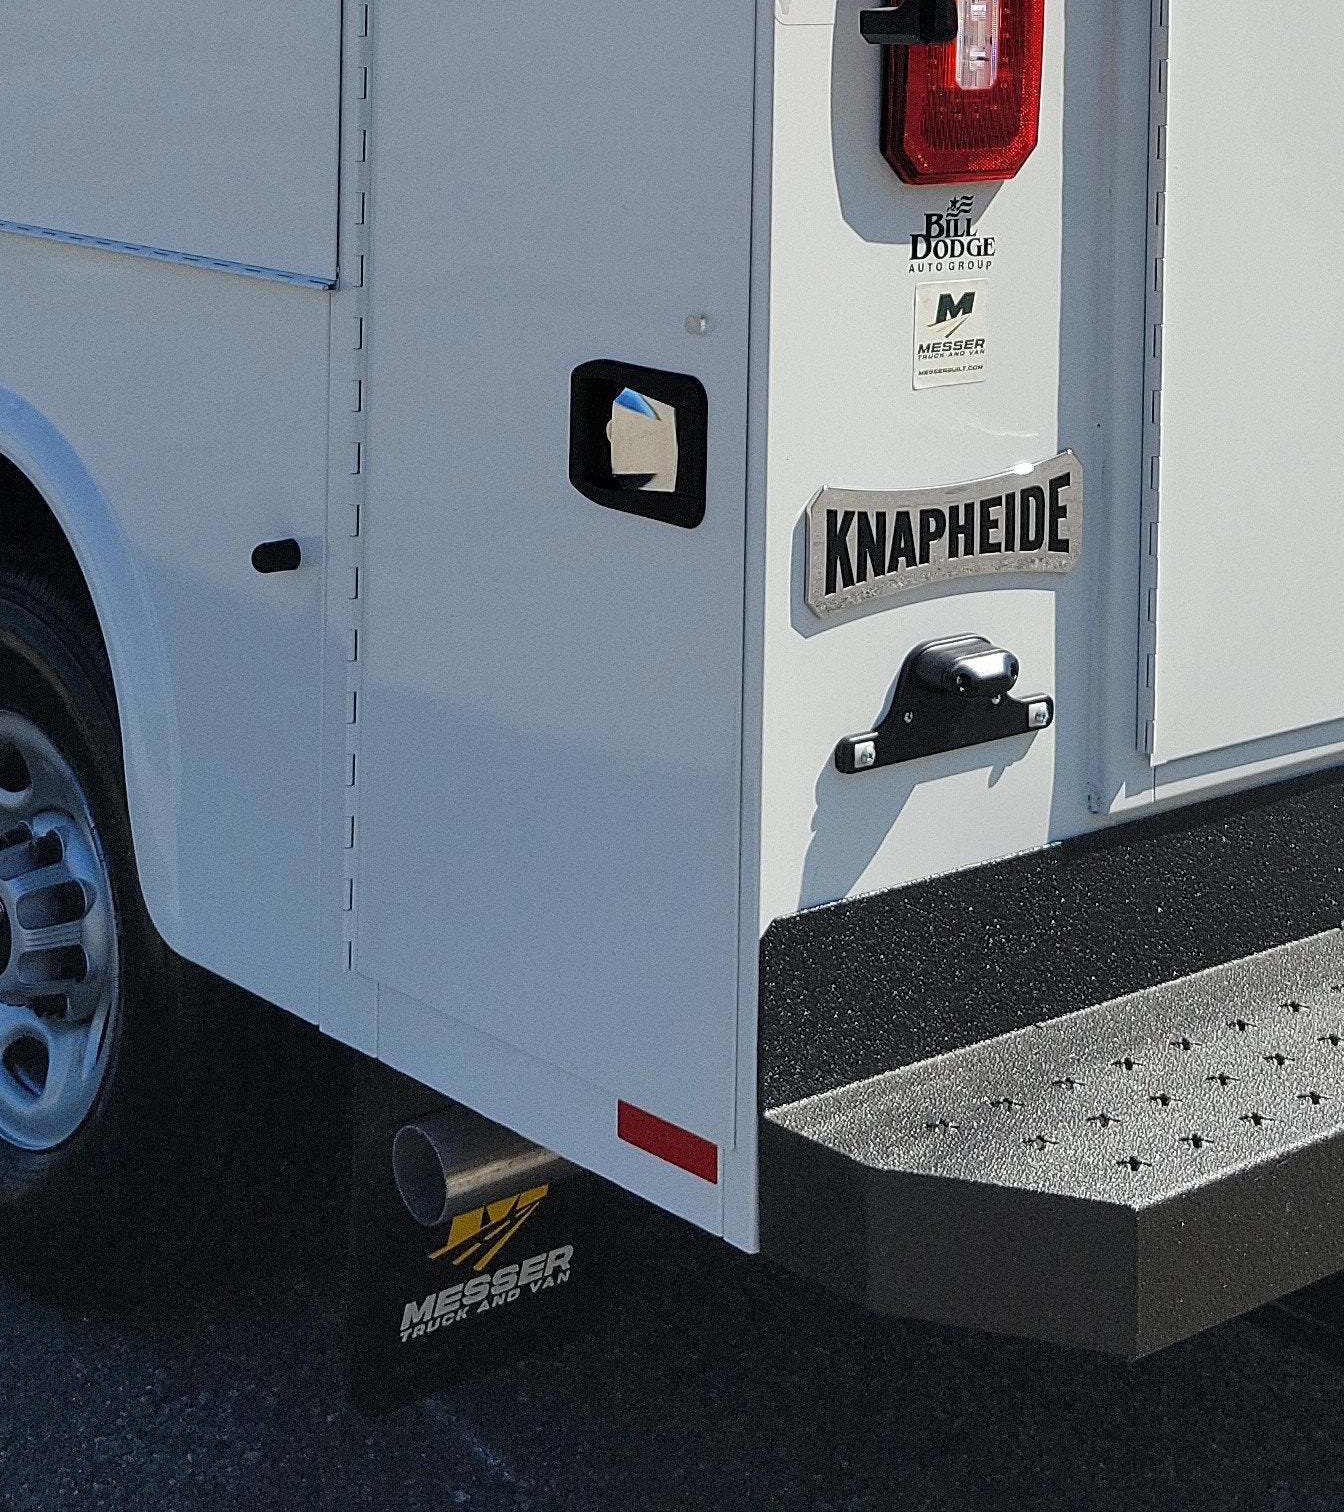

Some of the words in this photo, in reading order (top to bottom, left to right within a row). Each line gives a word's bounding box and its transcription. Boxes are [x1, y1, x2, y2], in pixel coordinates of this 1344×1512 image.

[924, 213, 978, 238] BILL
[909, 234, 996, 260] DODGE
[908, 263, 943, 273] AUTO
[948, 260, 992, 270] GROUP
[935, 291, 976, 324] M
[917, 352, 945, 361] TRUCK
[947, 350, 965, 358] AND
[969, 348, 985, 356] VAN
[918, 338, 986, 354] MESSER
[824, 472, 1071, 595] KNAPHEIDE
[400, 1245, 575, 1331] MESSER
[399, 1306, 469, 1343] TRUCK
[476, 1290, 520, 1314] AND
[529, 1269, 571, 1294] VAN
